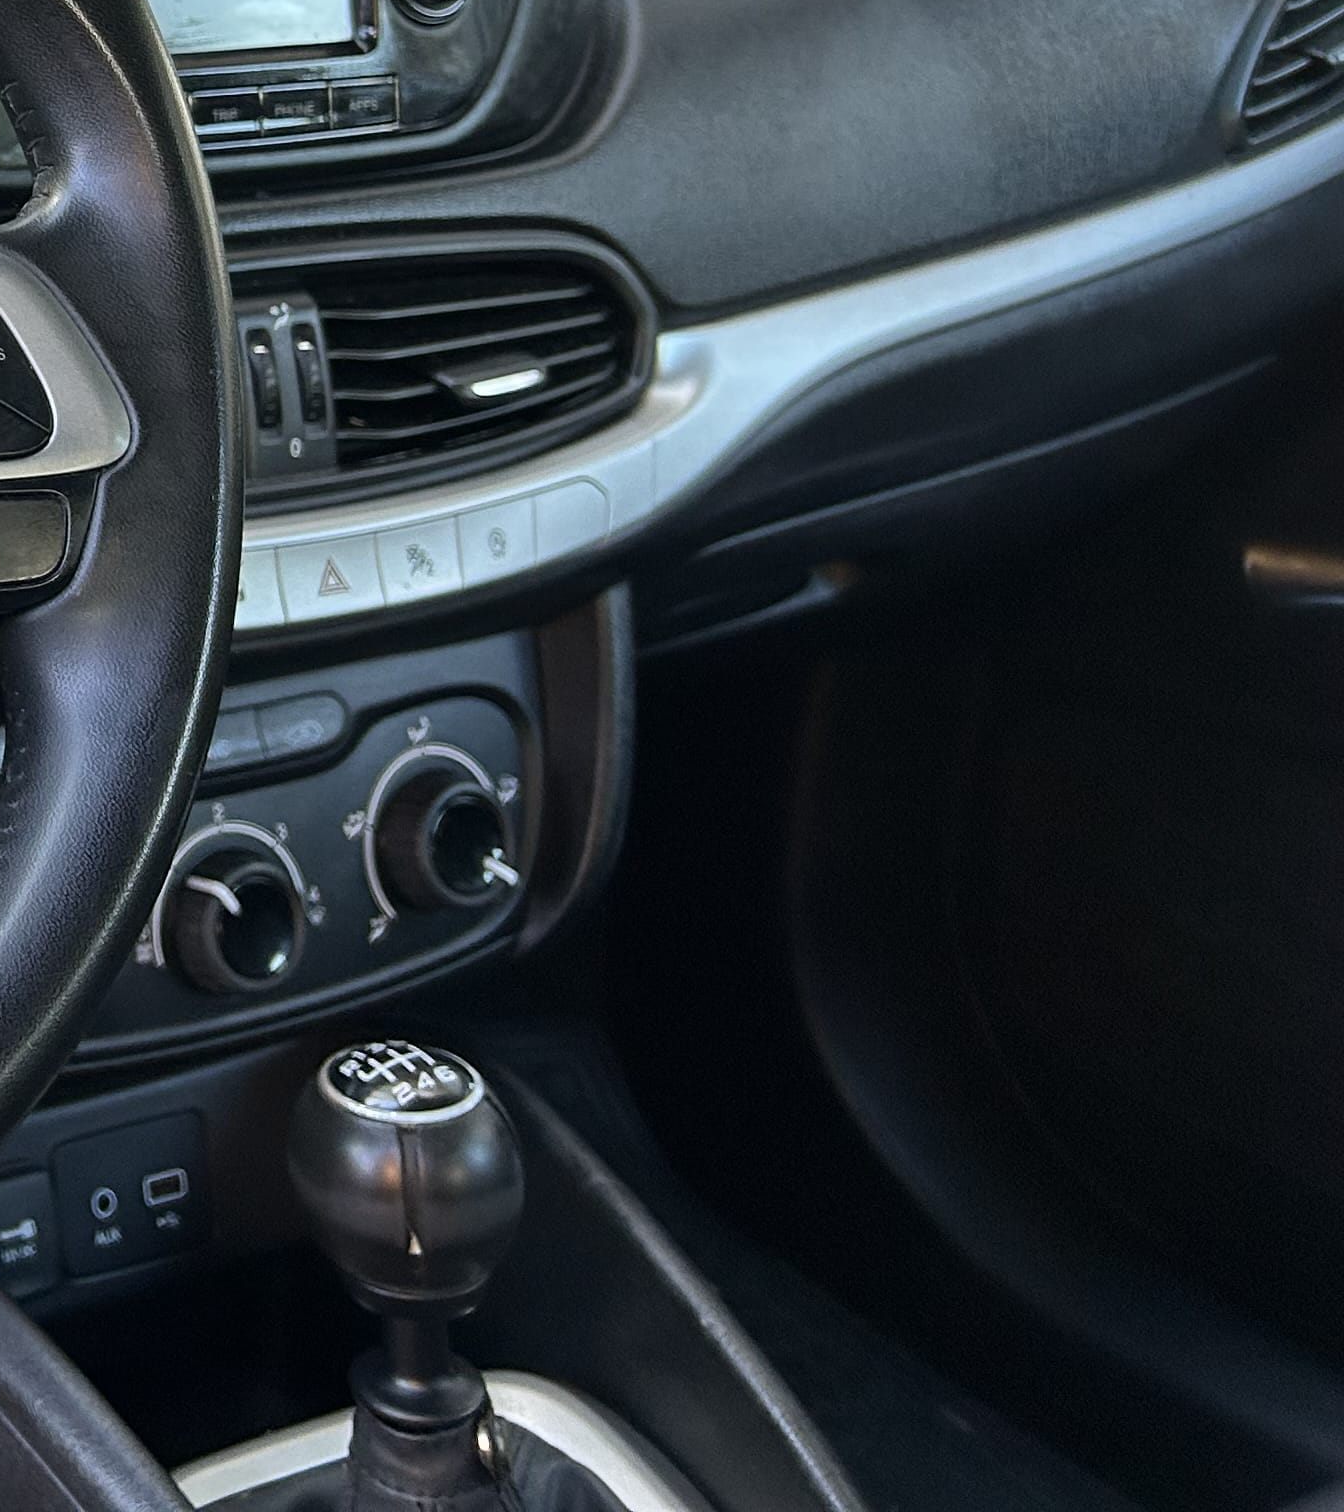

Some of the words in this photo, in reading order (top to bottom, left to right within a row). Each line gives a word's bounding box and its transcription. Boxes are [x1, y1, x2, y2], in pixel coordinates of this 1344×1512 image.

[392, 1081, 417, 1106] 2
[417, 1071, 437, 1089] 4
[433, 1065, 458, 1083] 6
